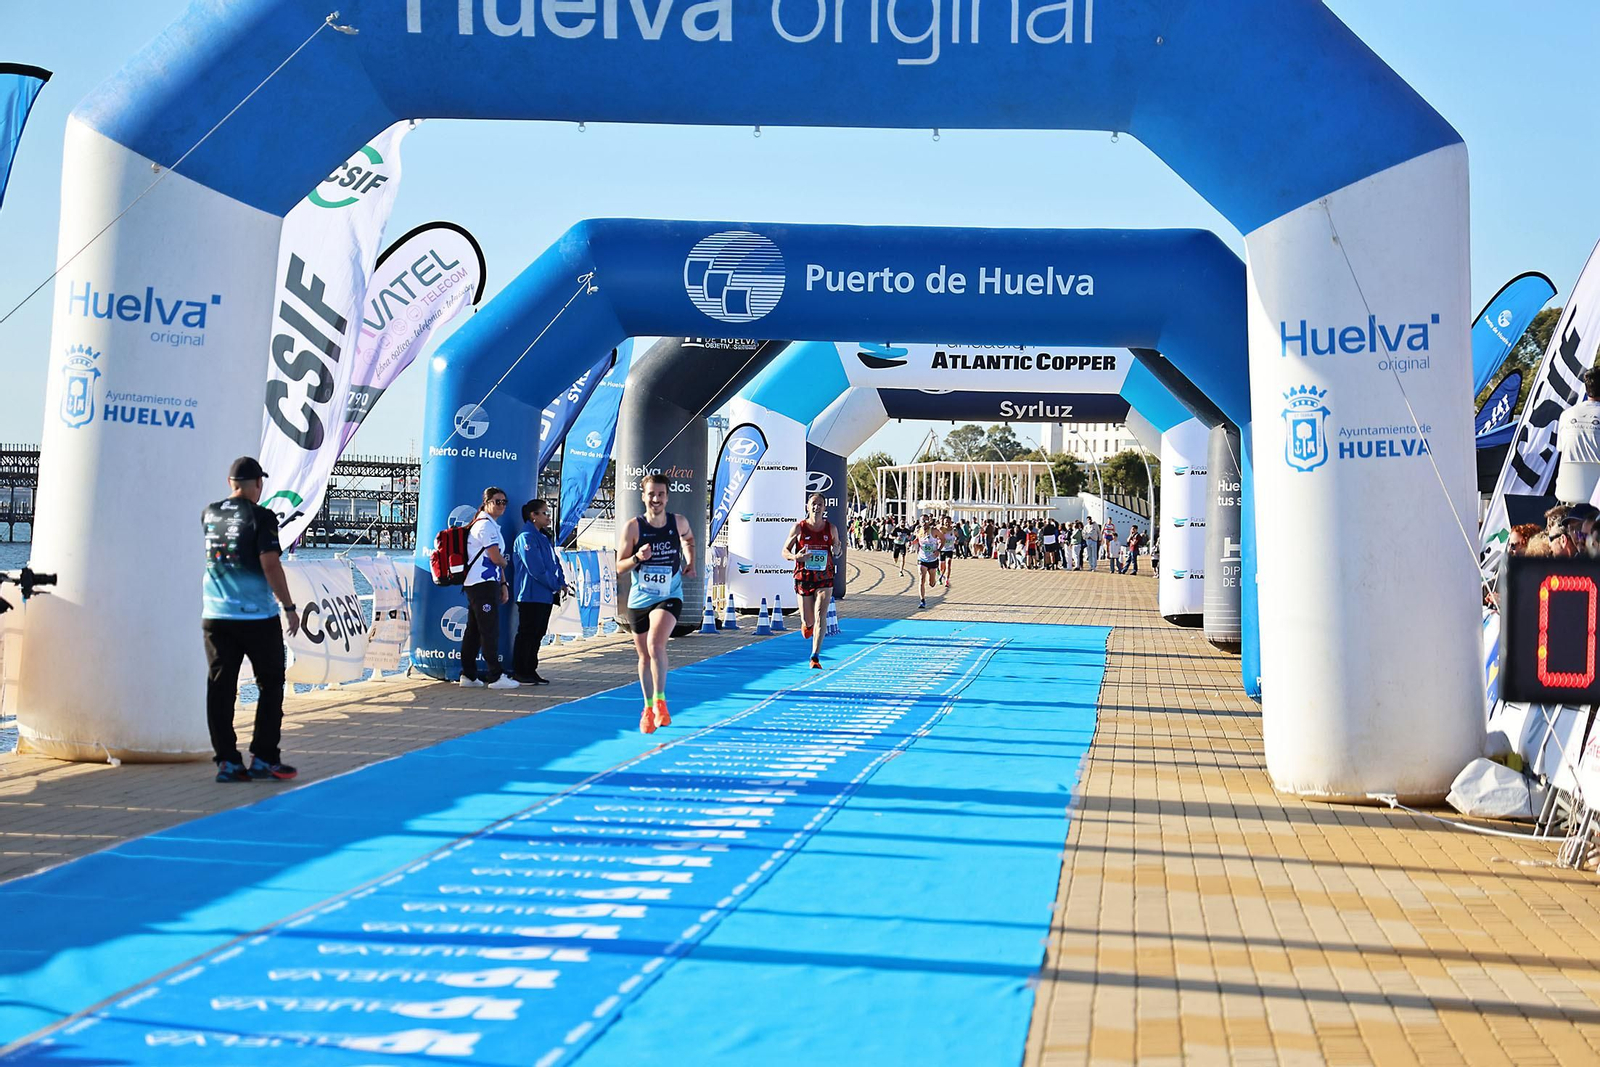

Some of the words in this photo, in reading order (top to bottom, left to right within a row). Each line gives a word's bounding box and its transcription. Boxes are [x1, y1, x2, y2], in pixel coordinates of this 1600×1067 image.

[420, 267, 468, 307] TELECOM
[805, 264, 915, 294] Puerto
[925, 265, 967, 295] de
[978, 266, 1095, 296] Huelva
[69, 280, 207, 328] Huelva
[150, 331, 205, 347] original
[1280, 315, 1429, 357] Huelva
[265, 252, 348, 451] CSIF
[931, 351, 1033, 370] ATLANTIC
[1036, 353, 1116, 371] COPPER
[1378, 356, 1430, 373] original
[105, 390, 181, 407] Ayuntamiento
[184, 397, 198, 407] de
[103, 404, 195, 429] HUELVA
[1000, 400, 1073, 420] Syrluz
[1339, 425, 1417, 438] Ayuntamiento
[1420, 424, 1432, 434] de
[429, 446, 458, 457] Puerto
[461, 447, 475, 457] de
[479, 448, 517, 460] Huelva
[1339, 438, 1432, 459] HUELVA
[664, 465, 694, 478] eleva
[623, 481, 637, 491] tus
[1217, 480, 1241, 492] Hue
[1217, 496, 1234, 506] tus
[652, 541, 671, 551] HGC
[643, 573, 666, 584] 648
[1538, 576, 1597, 688] 0
[416, 647, 445, 659] Puerto
[447, 649, 461, 660] de
